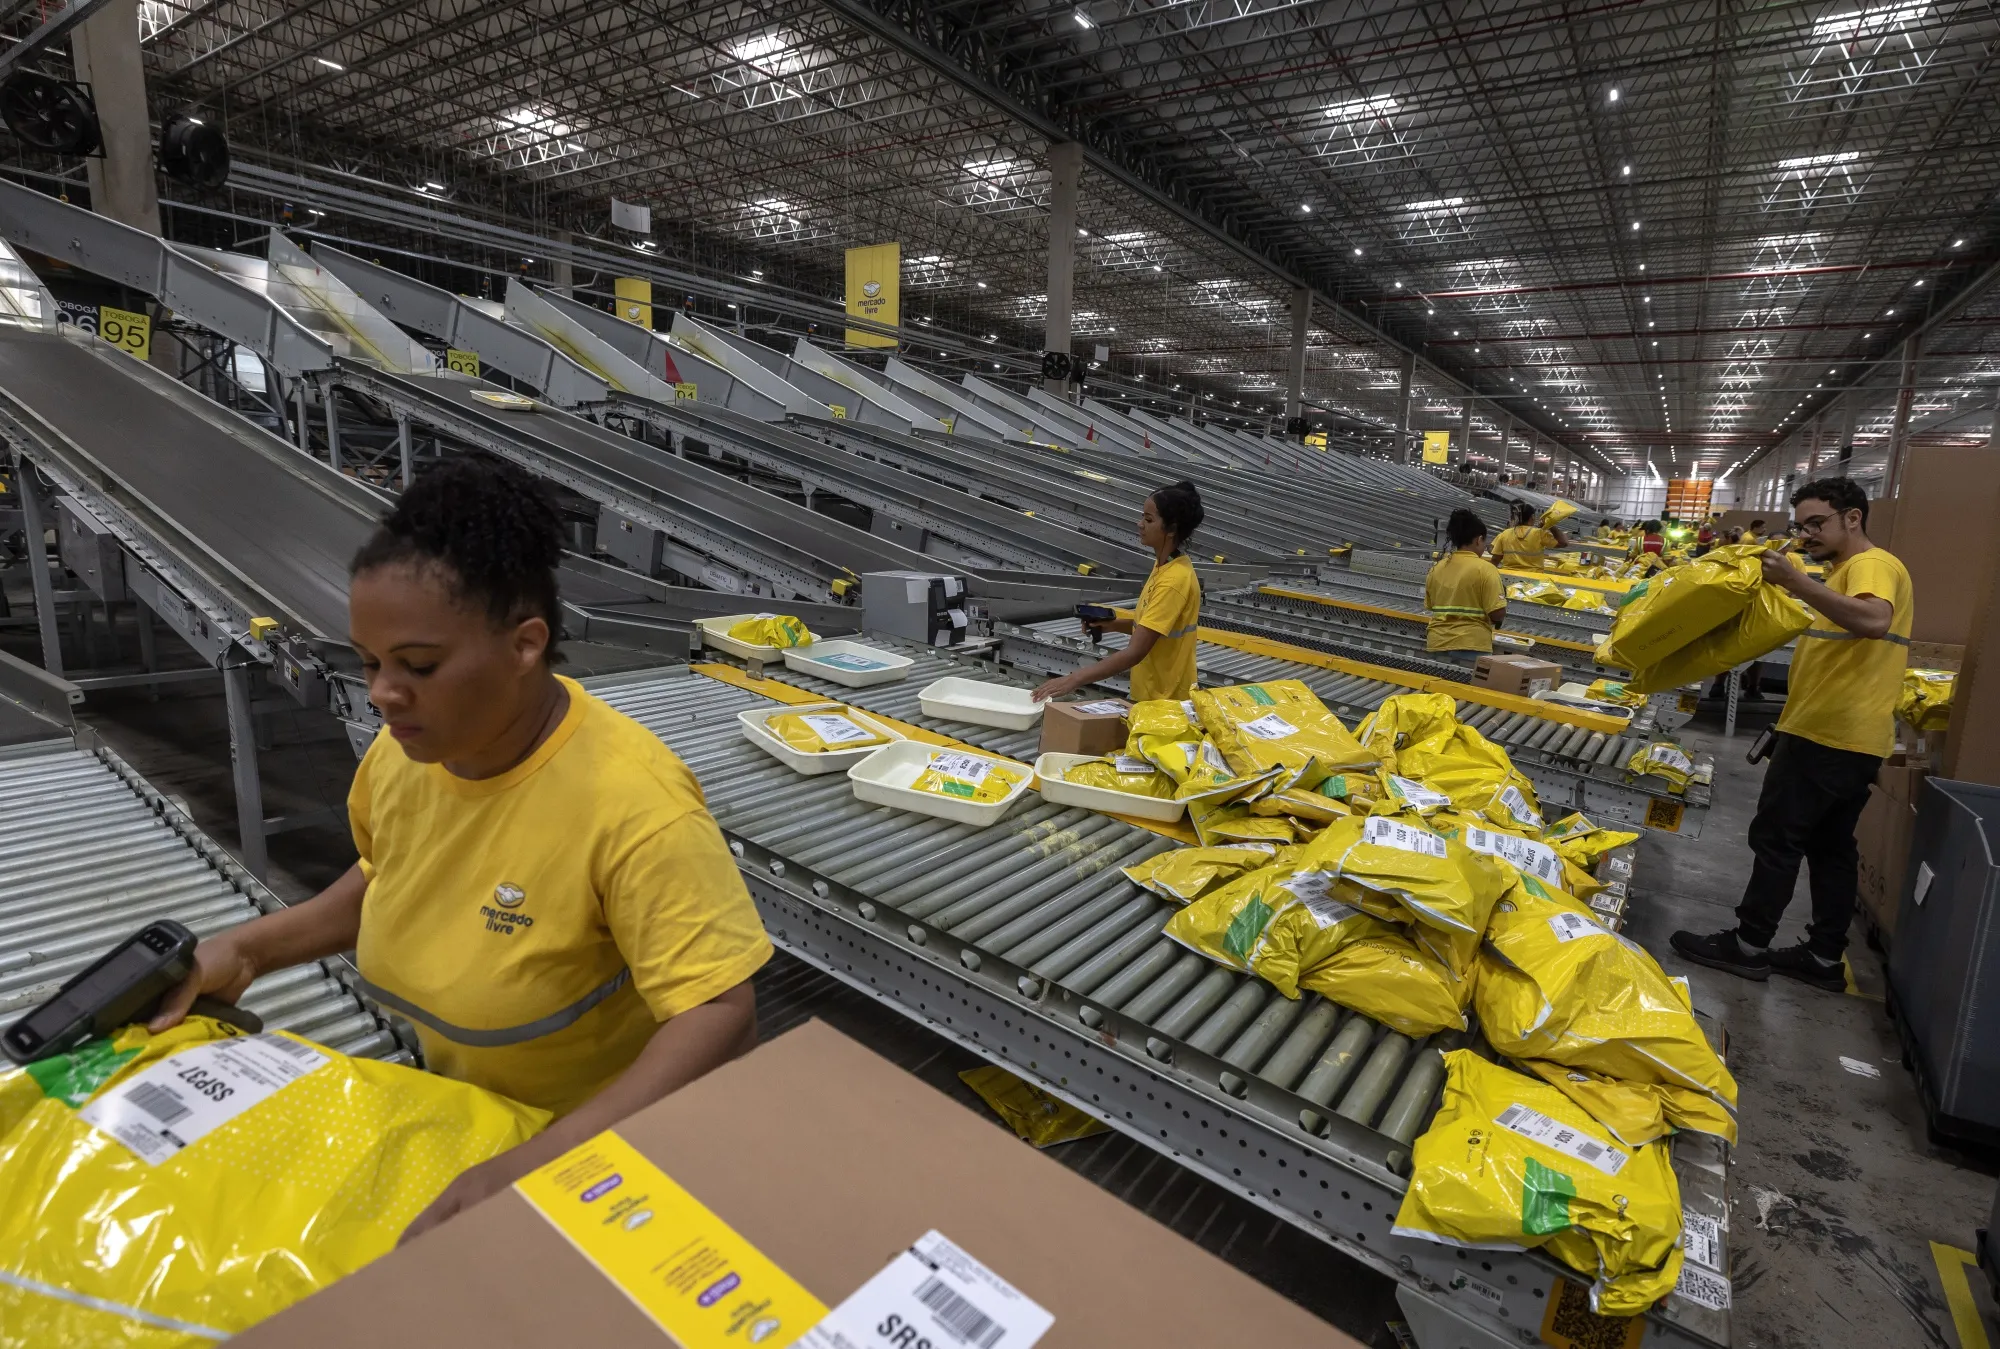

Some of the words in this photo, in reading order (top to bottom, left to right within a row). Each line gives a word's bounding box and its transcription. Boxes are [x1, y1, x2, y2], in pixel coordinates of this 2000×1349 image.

[858, 297, 886, 307] mercado
[864, 306, 878, 315] livre
[104, 321, 145, 347] 95
[480, 905, 534, 927] mercado
[485, 918, 514, 935] livre
[177, 1065, 235, 1103] SSP37
